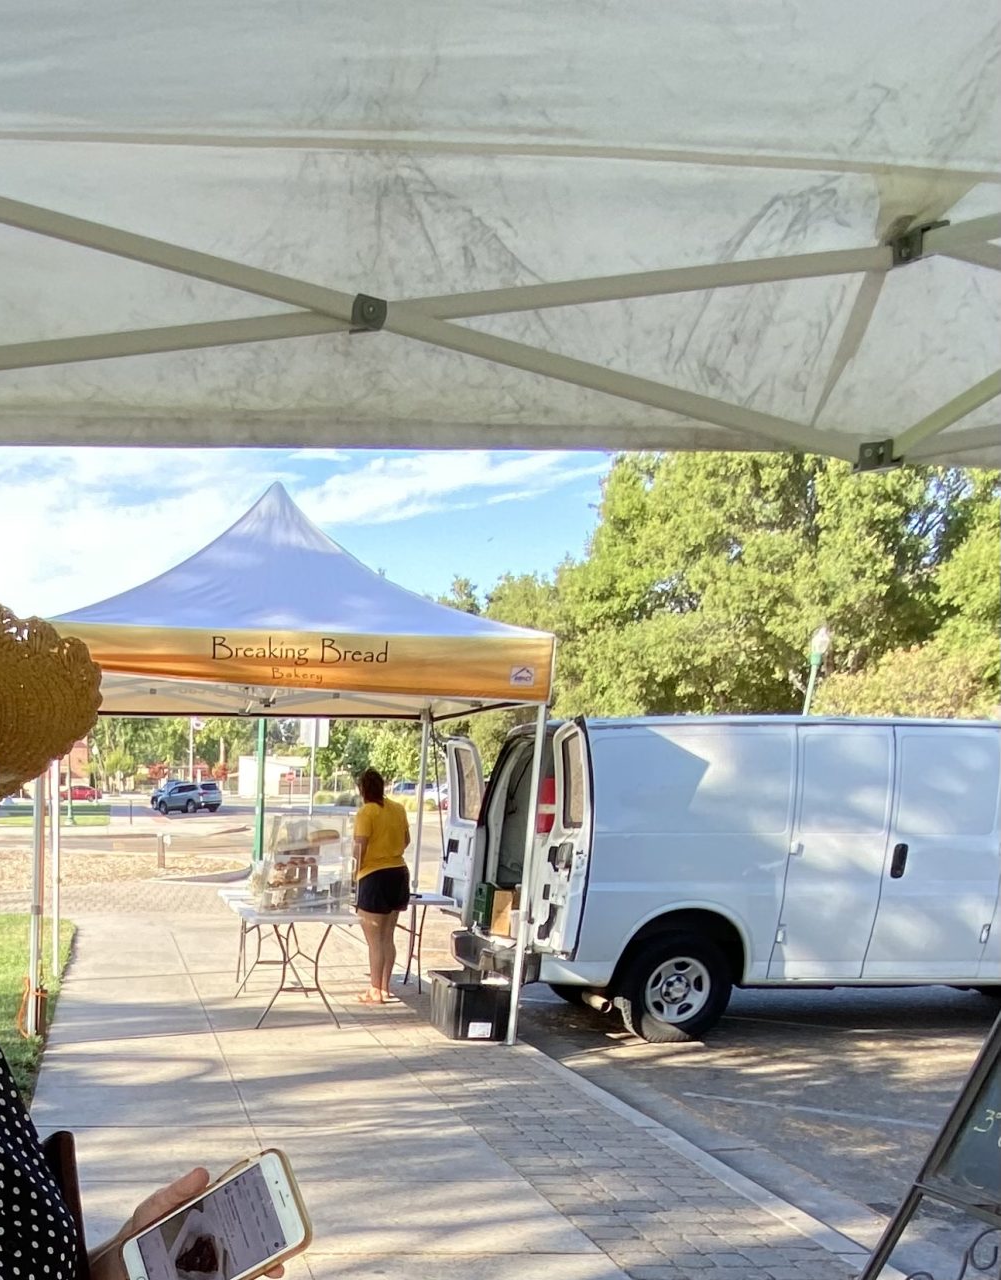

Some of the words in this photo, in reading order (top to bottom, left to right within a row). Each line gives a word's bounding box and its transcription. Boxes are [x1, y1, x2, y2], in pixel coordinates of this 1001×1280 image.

[212, 635, 309, 666] Breaking
[320, 637, 389, 664] Bread
[271, 666, 323, 684] Bakery
